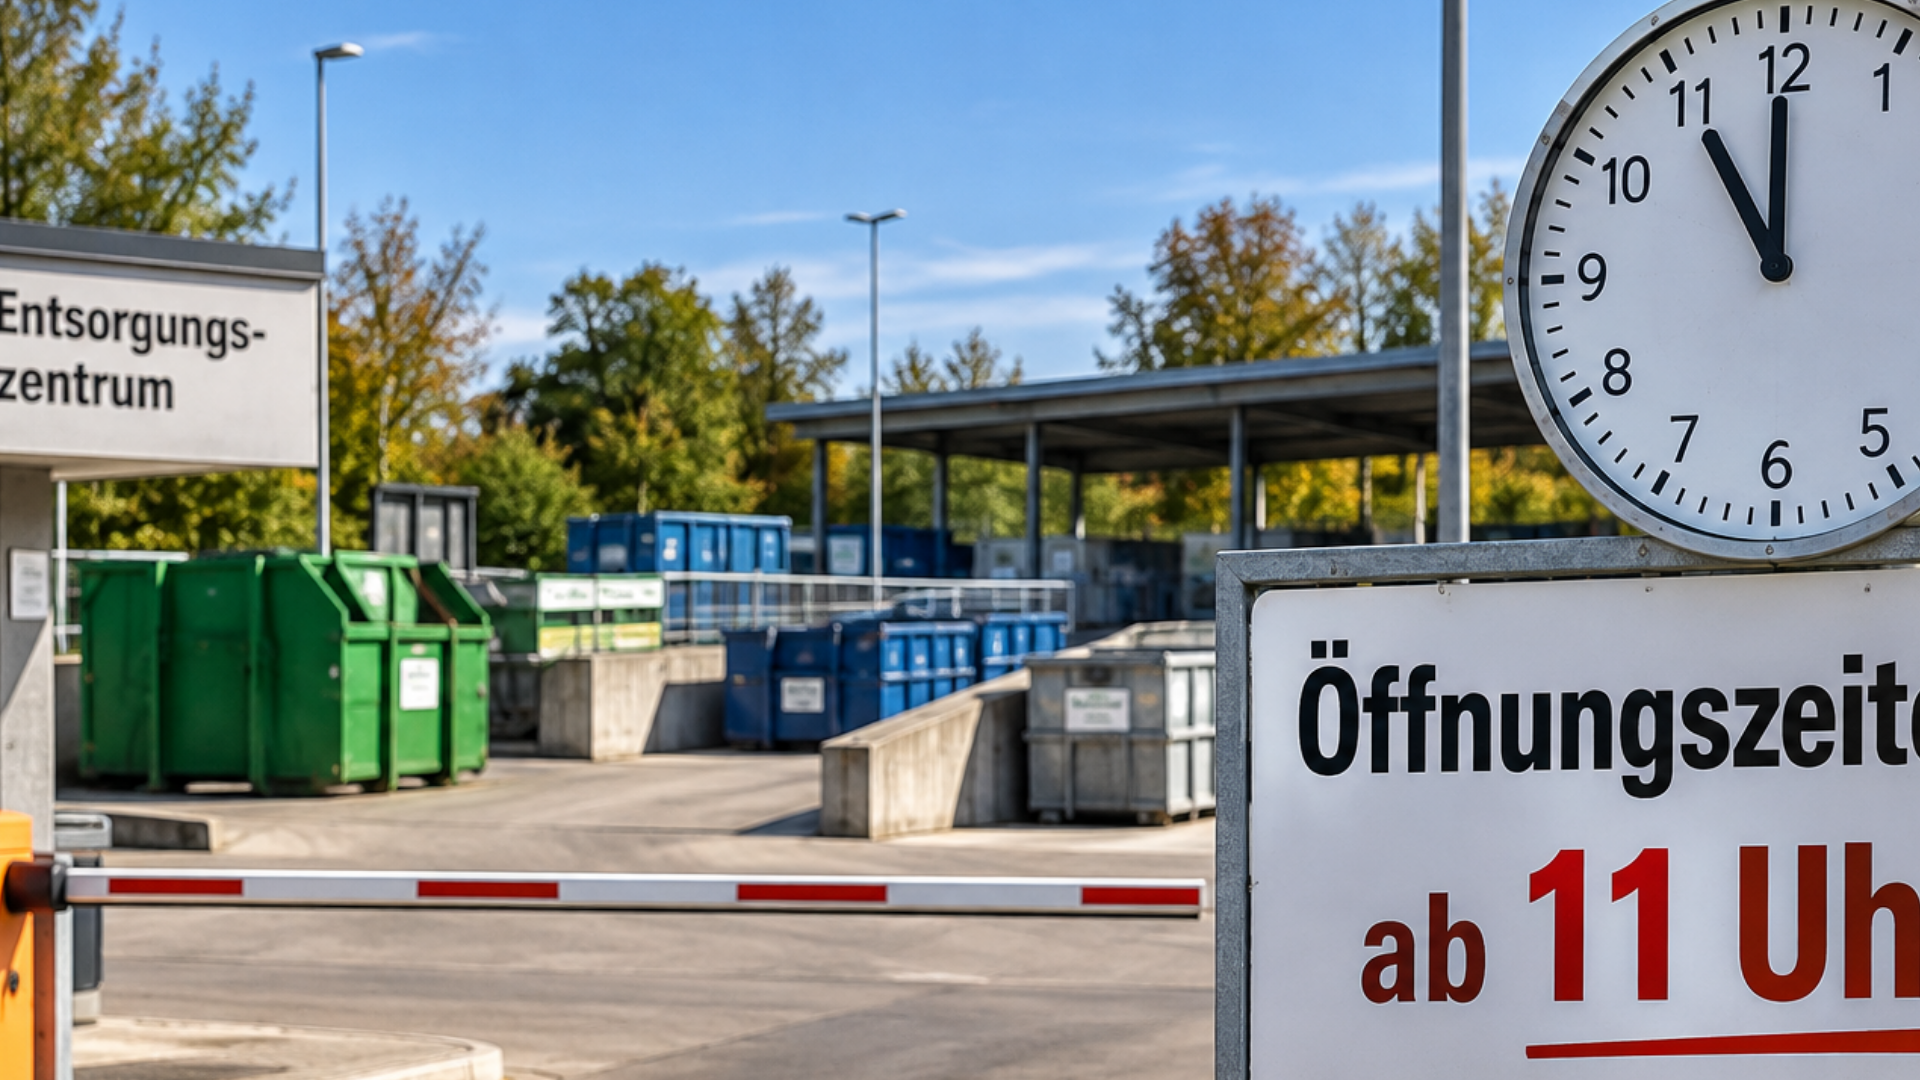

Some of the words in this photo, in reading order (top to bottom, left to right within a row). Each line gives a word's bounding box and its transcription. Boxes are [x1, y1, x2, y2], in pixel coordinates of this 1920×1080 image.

[1758, 42, 1811, 95] 12
[1873, 62, 1890, 112] 1
[1668, 77, 1711, 128] 11
[1602, 155, 1651, 205] 10
[1577, 252, 1608, 302] 9
[0, 289, 266, 360] Entsorgungs-
[0, 364, 174, 409] zentrum
[1602, 347, 1633, 397] 8
[1670, 414, 1699, 463] 7
[1859, 407, 1891, 458] 5
[1761, 439, 1793, 490] 6
[1299, 639, 1920, 799] Öffnungszeit
[1361, 891, 1486, 1004] ab
[1528, 847, 1669, 1002] 11
[1739, 841, 1920, 1003] Uh
